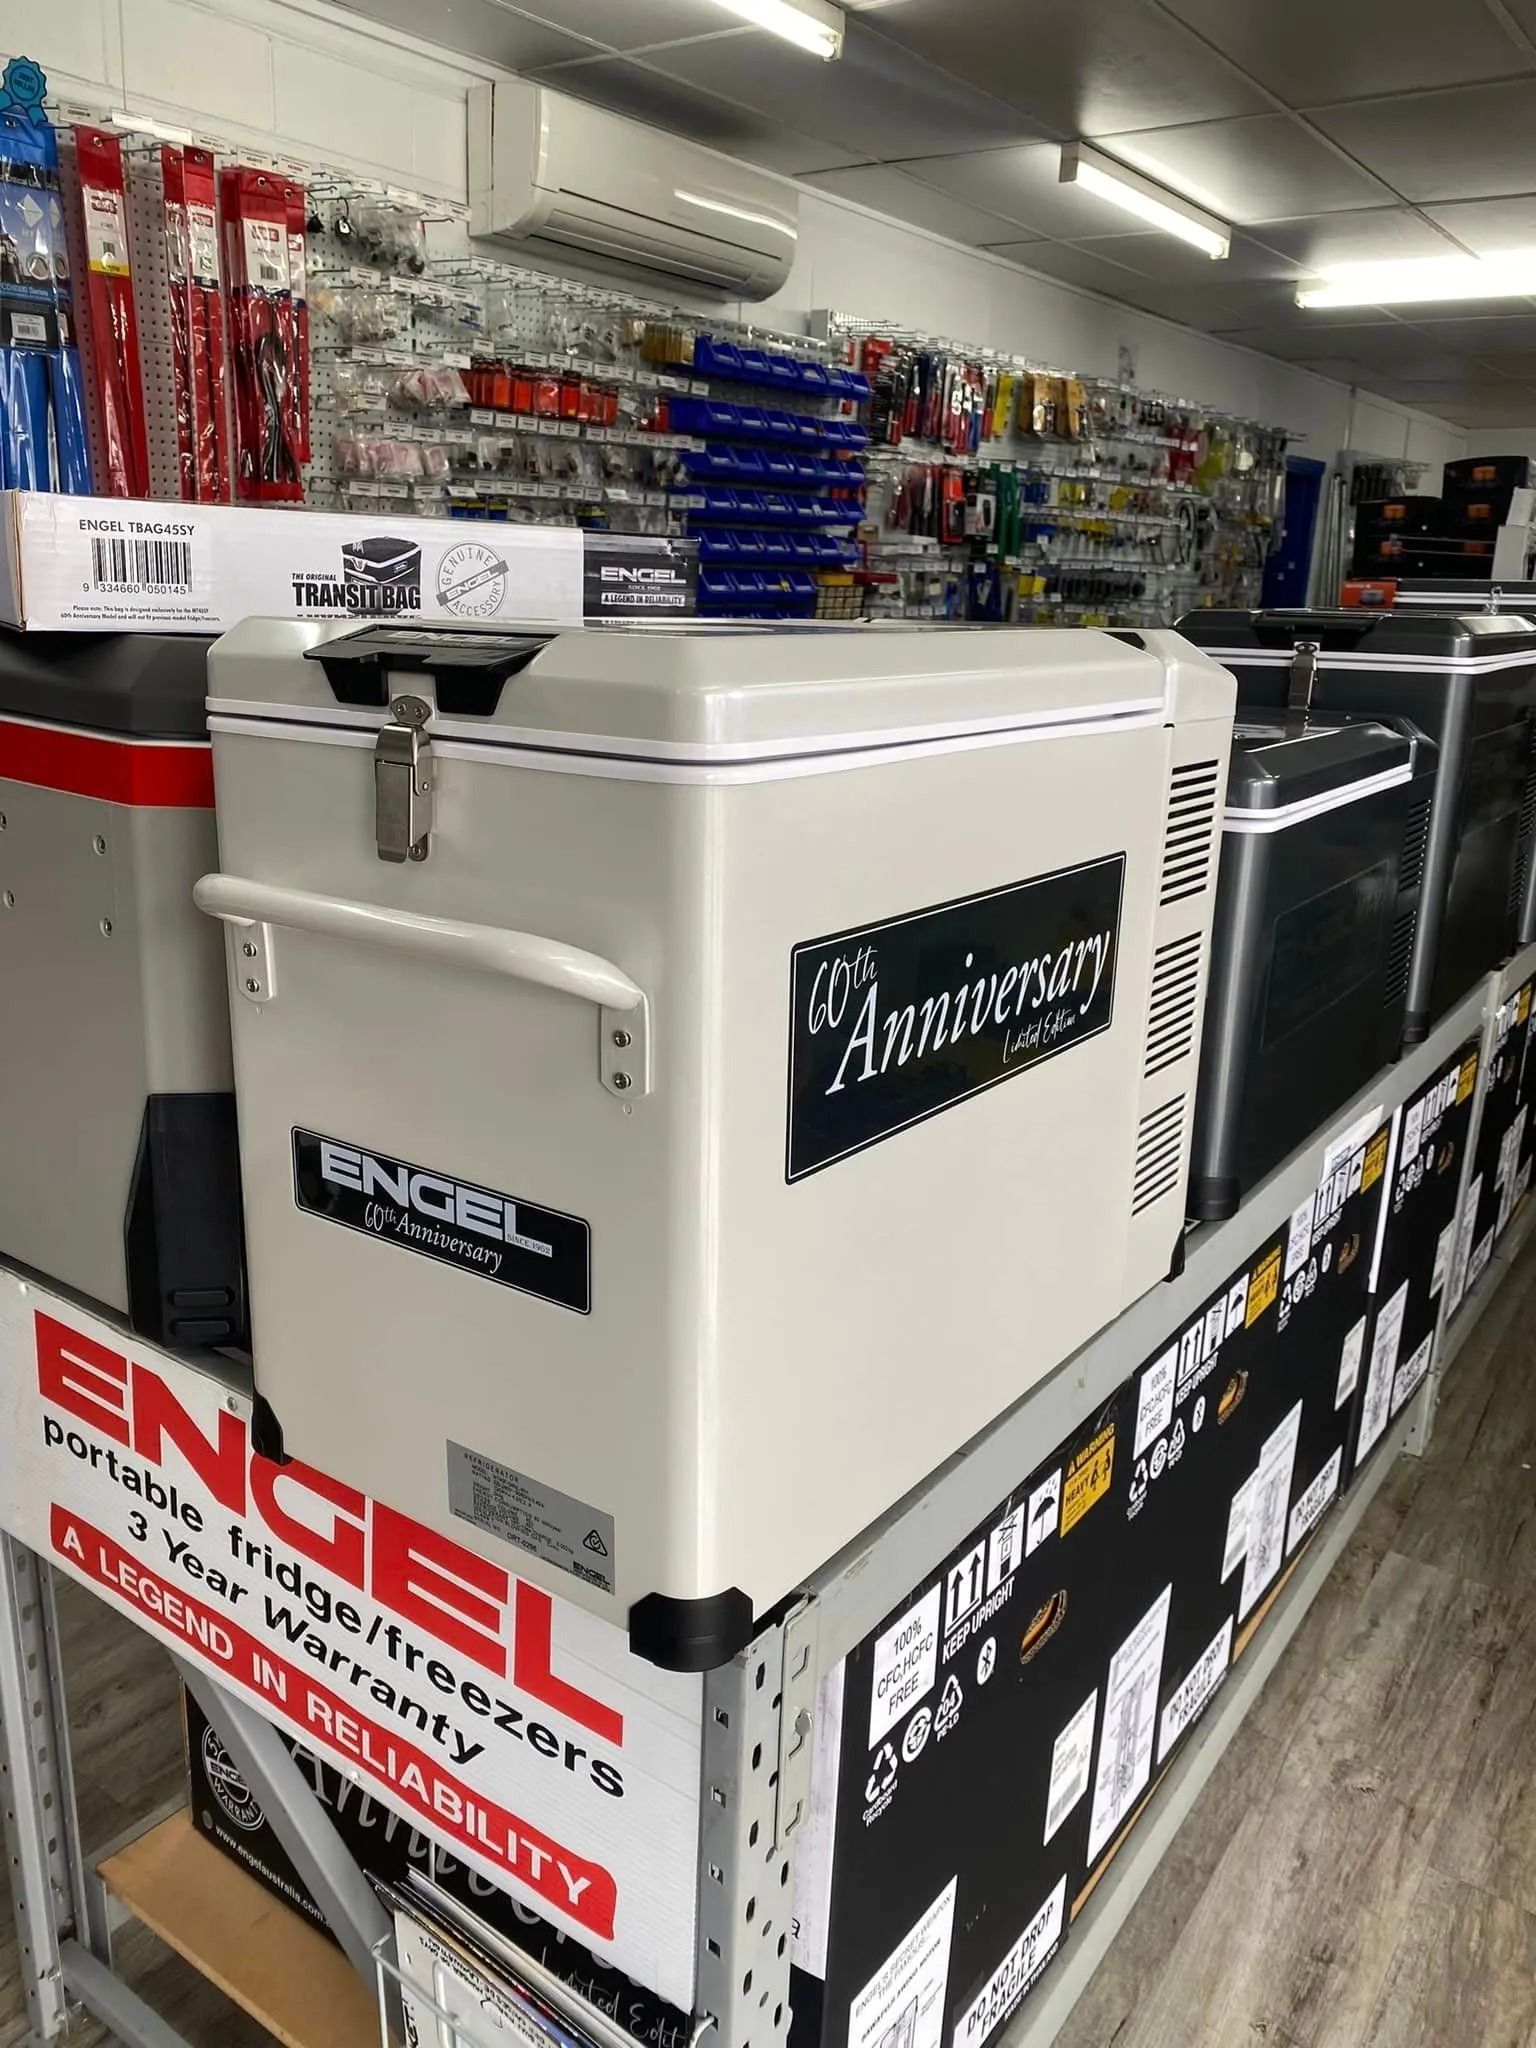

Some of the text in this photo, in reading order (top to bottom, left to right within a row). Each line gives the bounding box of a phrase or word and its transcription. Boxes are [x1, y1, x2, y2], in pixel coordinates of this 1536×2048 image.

[79, 519, 195, 536] ENGEL TBAG45SY
[82, 583, 187, 595] 9 334660 050145
[305, 573, 337, 582] ORIGINAL
[441, 547, 493, 586] GENUINE
[447, 572, 499, 600] ENGEL
[601, 566, 687, 584] ENGEL
[292, 582, 421, 610] TRANSIT BAG
[452, 580, 502, 617] ACCESSORY
[387, 631, 522, 645] ENGEL
[808, 945, 880, 1035] 60th
[824, 930, 1111, 1096] Anniversary
[1003, 1008, 1077, 1064] Limited Edition
[320, 1141, 553, 1258] ENGEL
[364, 1201, 503, 1275] 60th Anniversary
[506, 1232, 530, 1250] SINCE
[464, 1452, 520, 1483] REFRIGERATOR
[1076, 1421, 1116, 1470] WARNING
[1065, 1474, 1090, 1507] HEAVY
[34, 1309, 624, 1747] ENGEL
[572, 1560, 611, 1586] ENGEL
[42, 1414, 626, 1798] portable fridge/freezers
[942, 1576, 1015, 1665] KEEP UPRIGHT
[127, 1510, 486, 1767] 3 Year Warranty
[893, 1615, 922, 1657] 100%
[888, 1671, 920, 1717] FREE
[62, 1529, 593, 1906] A LEGEND IN RELIABILITY
[214, 1776, 260, 1823] WARRANT
[967, 1901, 1054, 2038] DO NOT DROP
[981, 1945, 1037, 2039] FRAGILE
